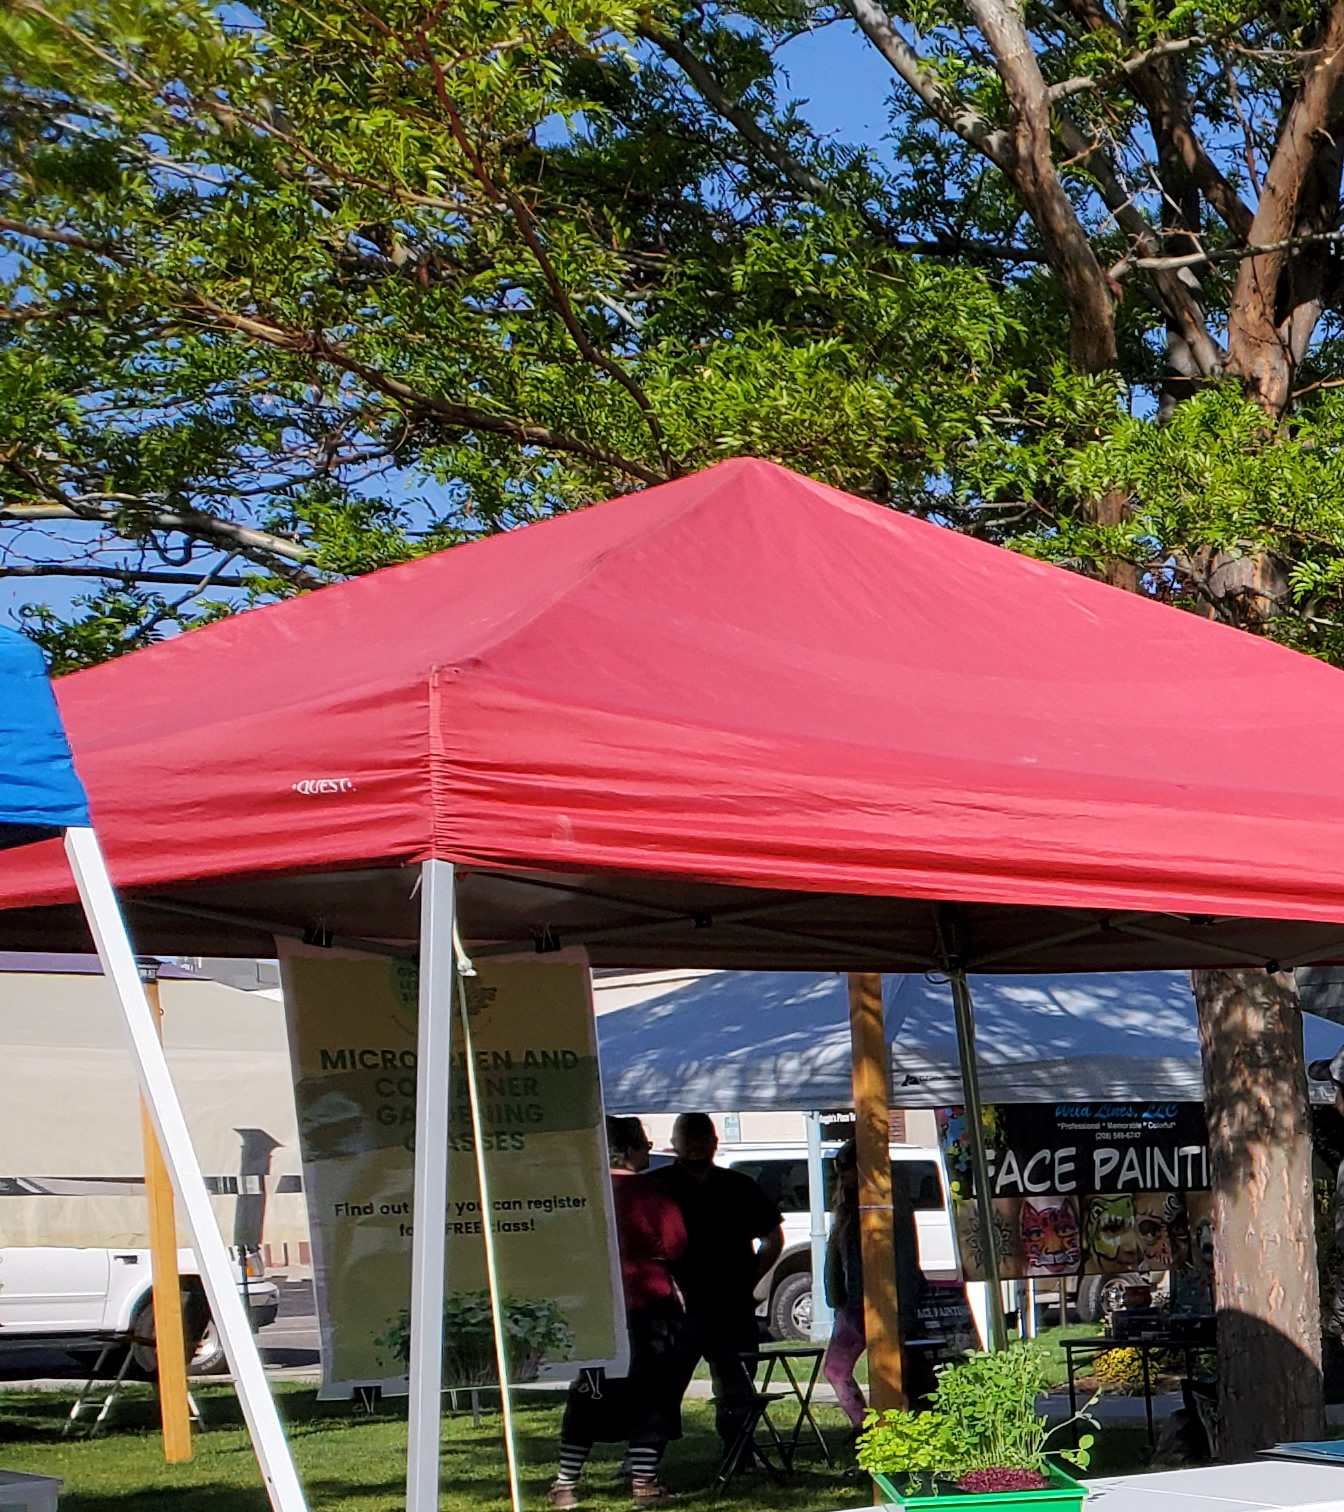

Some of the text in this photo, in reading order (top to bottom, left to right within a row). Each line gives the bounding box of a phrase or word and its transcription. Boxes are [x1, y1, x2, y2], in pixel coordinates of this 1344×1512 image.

[321, 1049, 578, 1071] MICROEN AND
[375, 1077, 539, 1098] COANER
[376, 1103, 543, 1126] GAEING
[1094, 1145, 1211, 1191] PAINTI
[334, 1202, 374, 1217] Find
[380, 1201, 409, 1216] out
[527, 1196, 587, 1213] register
[399, 1222, 415, 1238] fo
[493, 1217, 535, 1234] lass!
